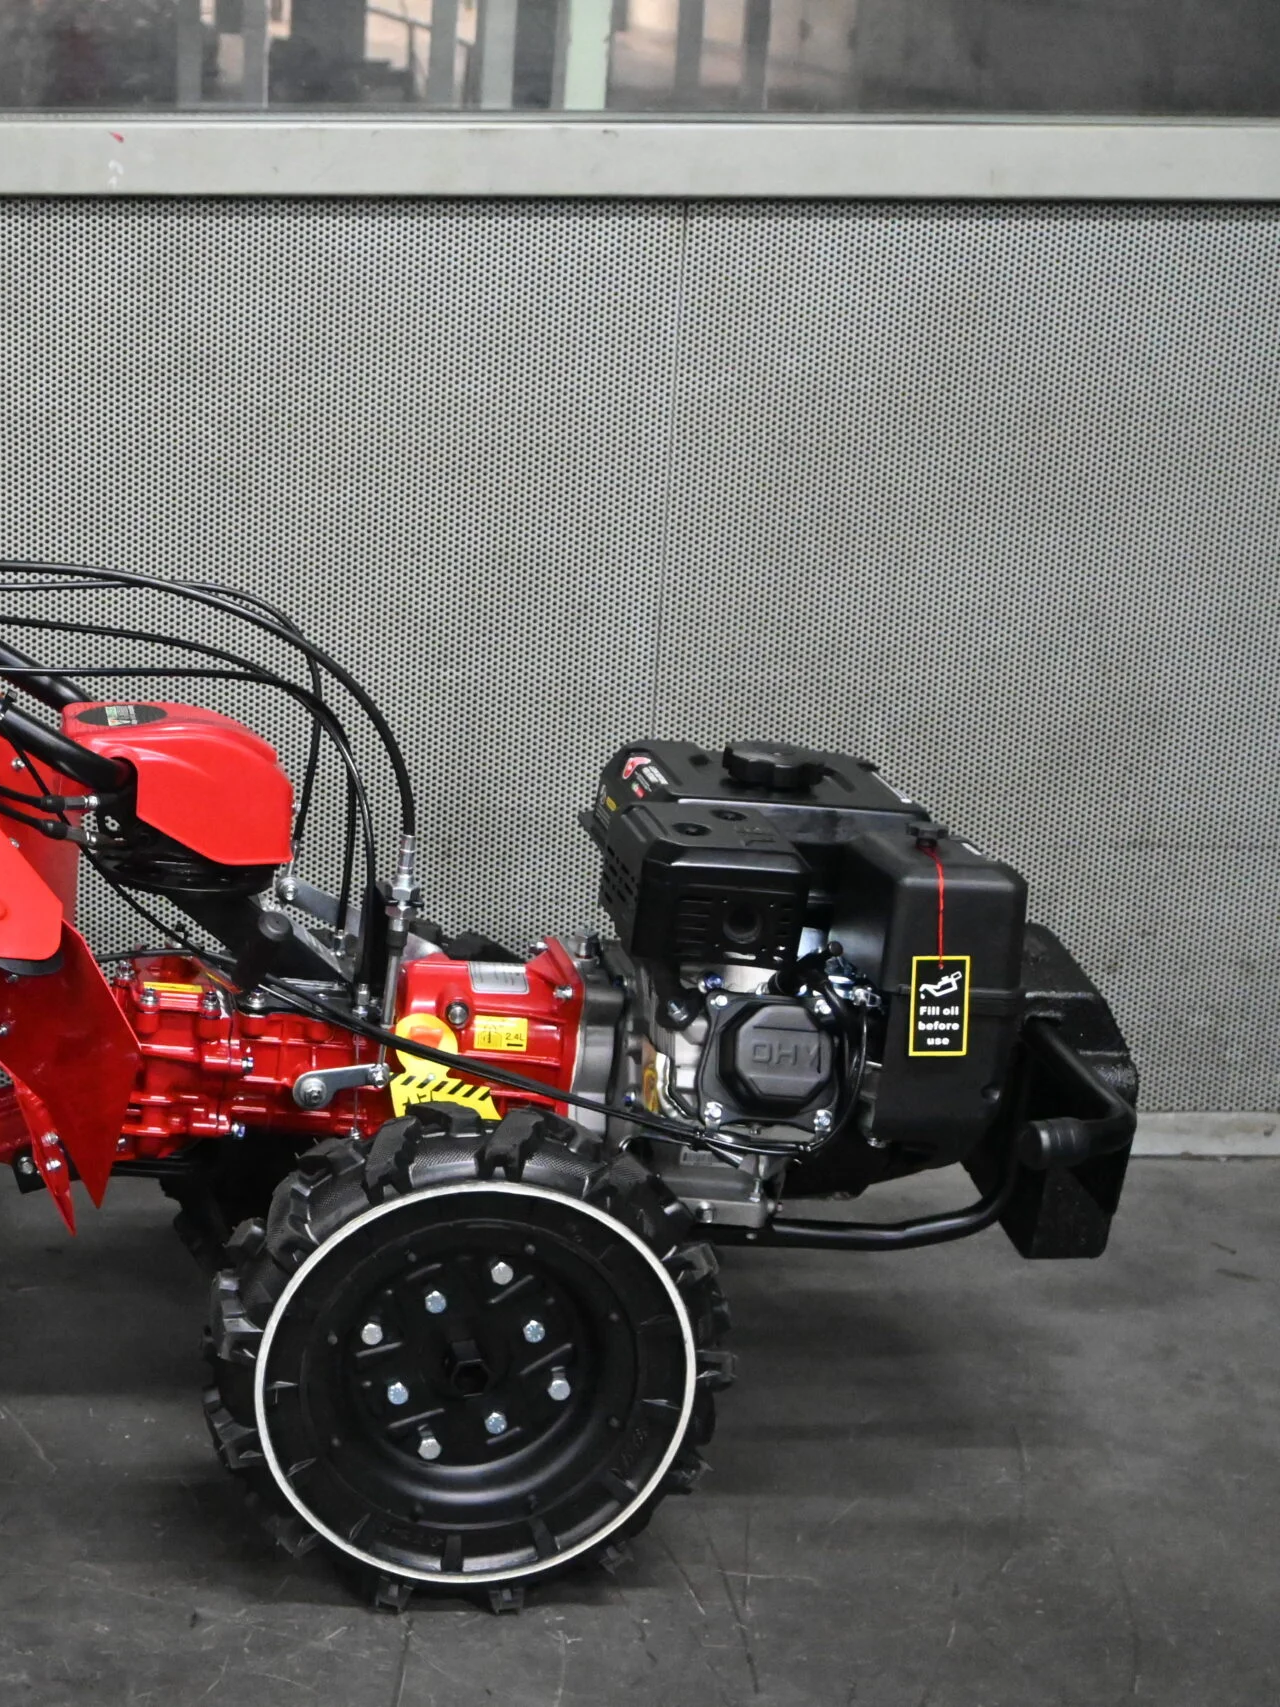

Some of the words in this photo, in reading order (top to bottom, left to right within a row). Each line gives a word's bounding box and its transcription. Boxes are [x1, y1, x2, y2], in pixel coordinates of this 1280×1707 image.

[919, 1006, 940, 1016] Fill
[942, 1006, 959, 1016] oil
[917, 1021, 960, 1031] before
[926, 1037, 950, 1046] use
